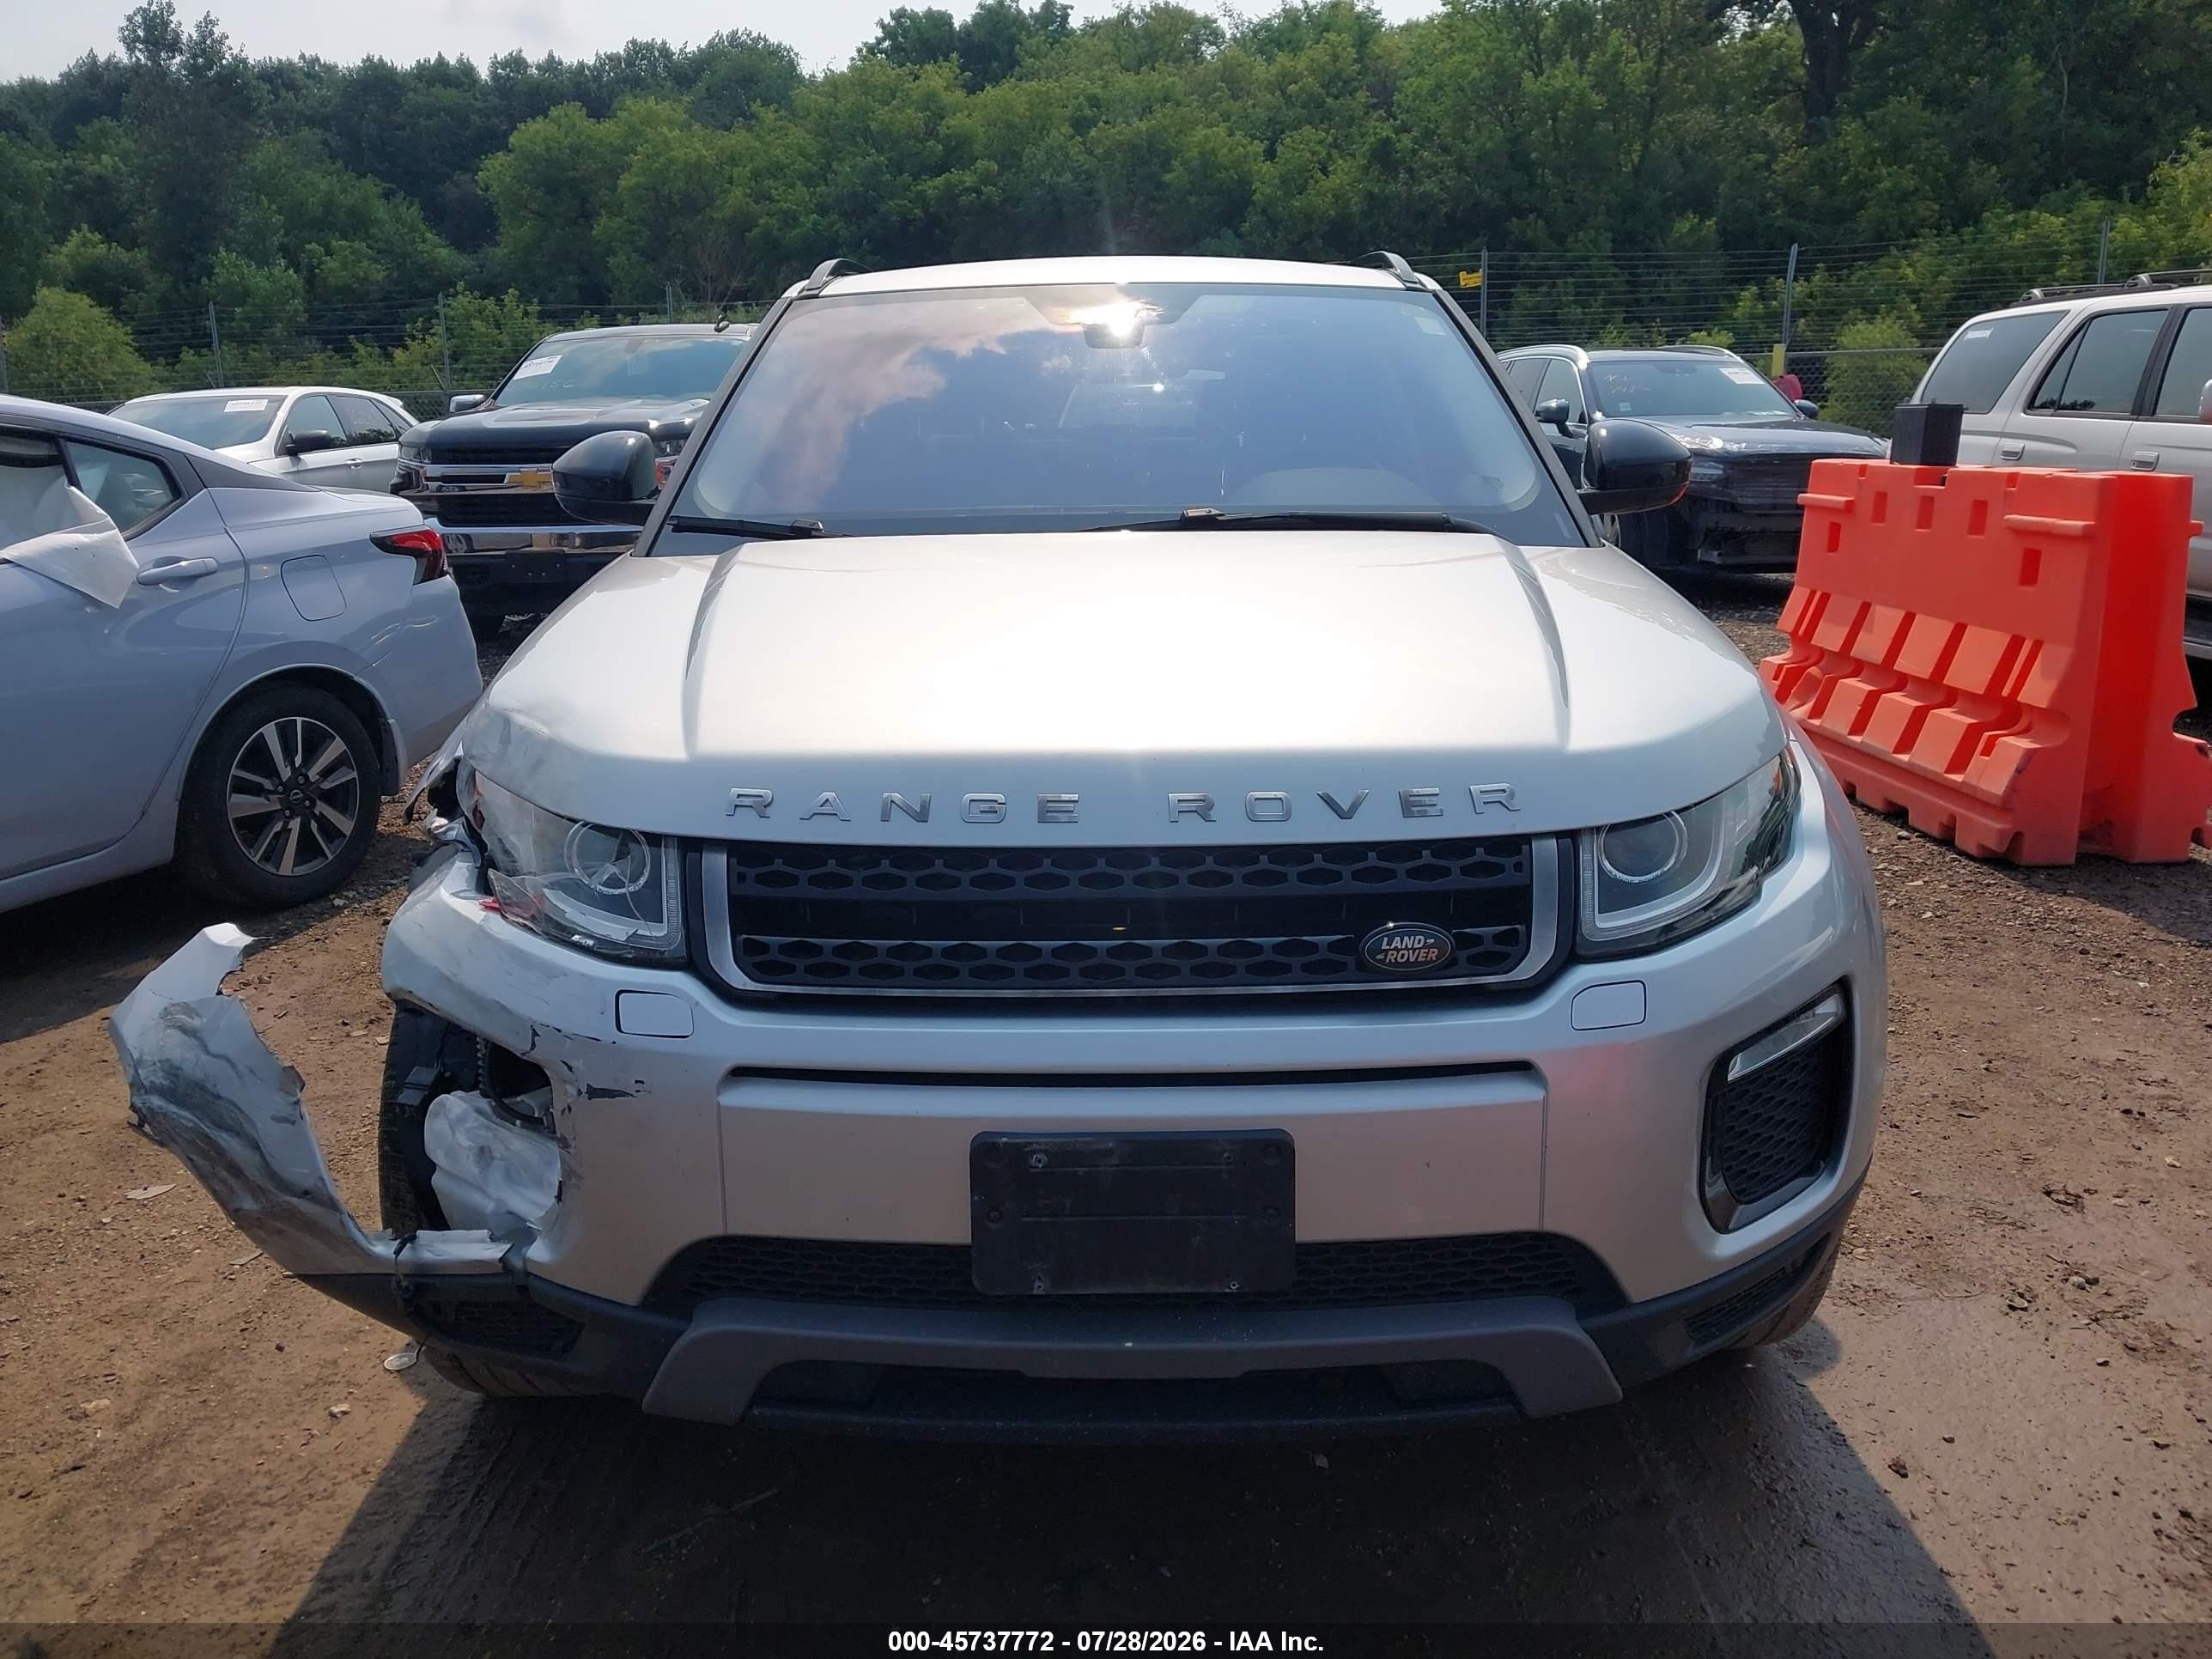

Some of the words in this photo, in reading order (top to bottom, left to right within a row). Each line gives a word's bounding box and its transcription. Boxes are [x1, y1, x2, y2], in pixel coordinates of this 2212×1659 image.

[726, 787, 1080, 823] RANGE
[1168, 781, 1522, 823] ROVER
[1382, 936, 1425, 949] LAND
[1386, 948, 1438, 963] ROVER
